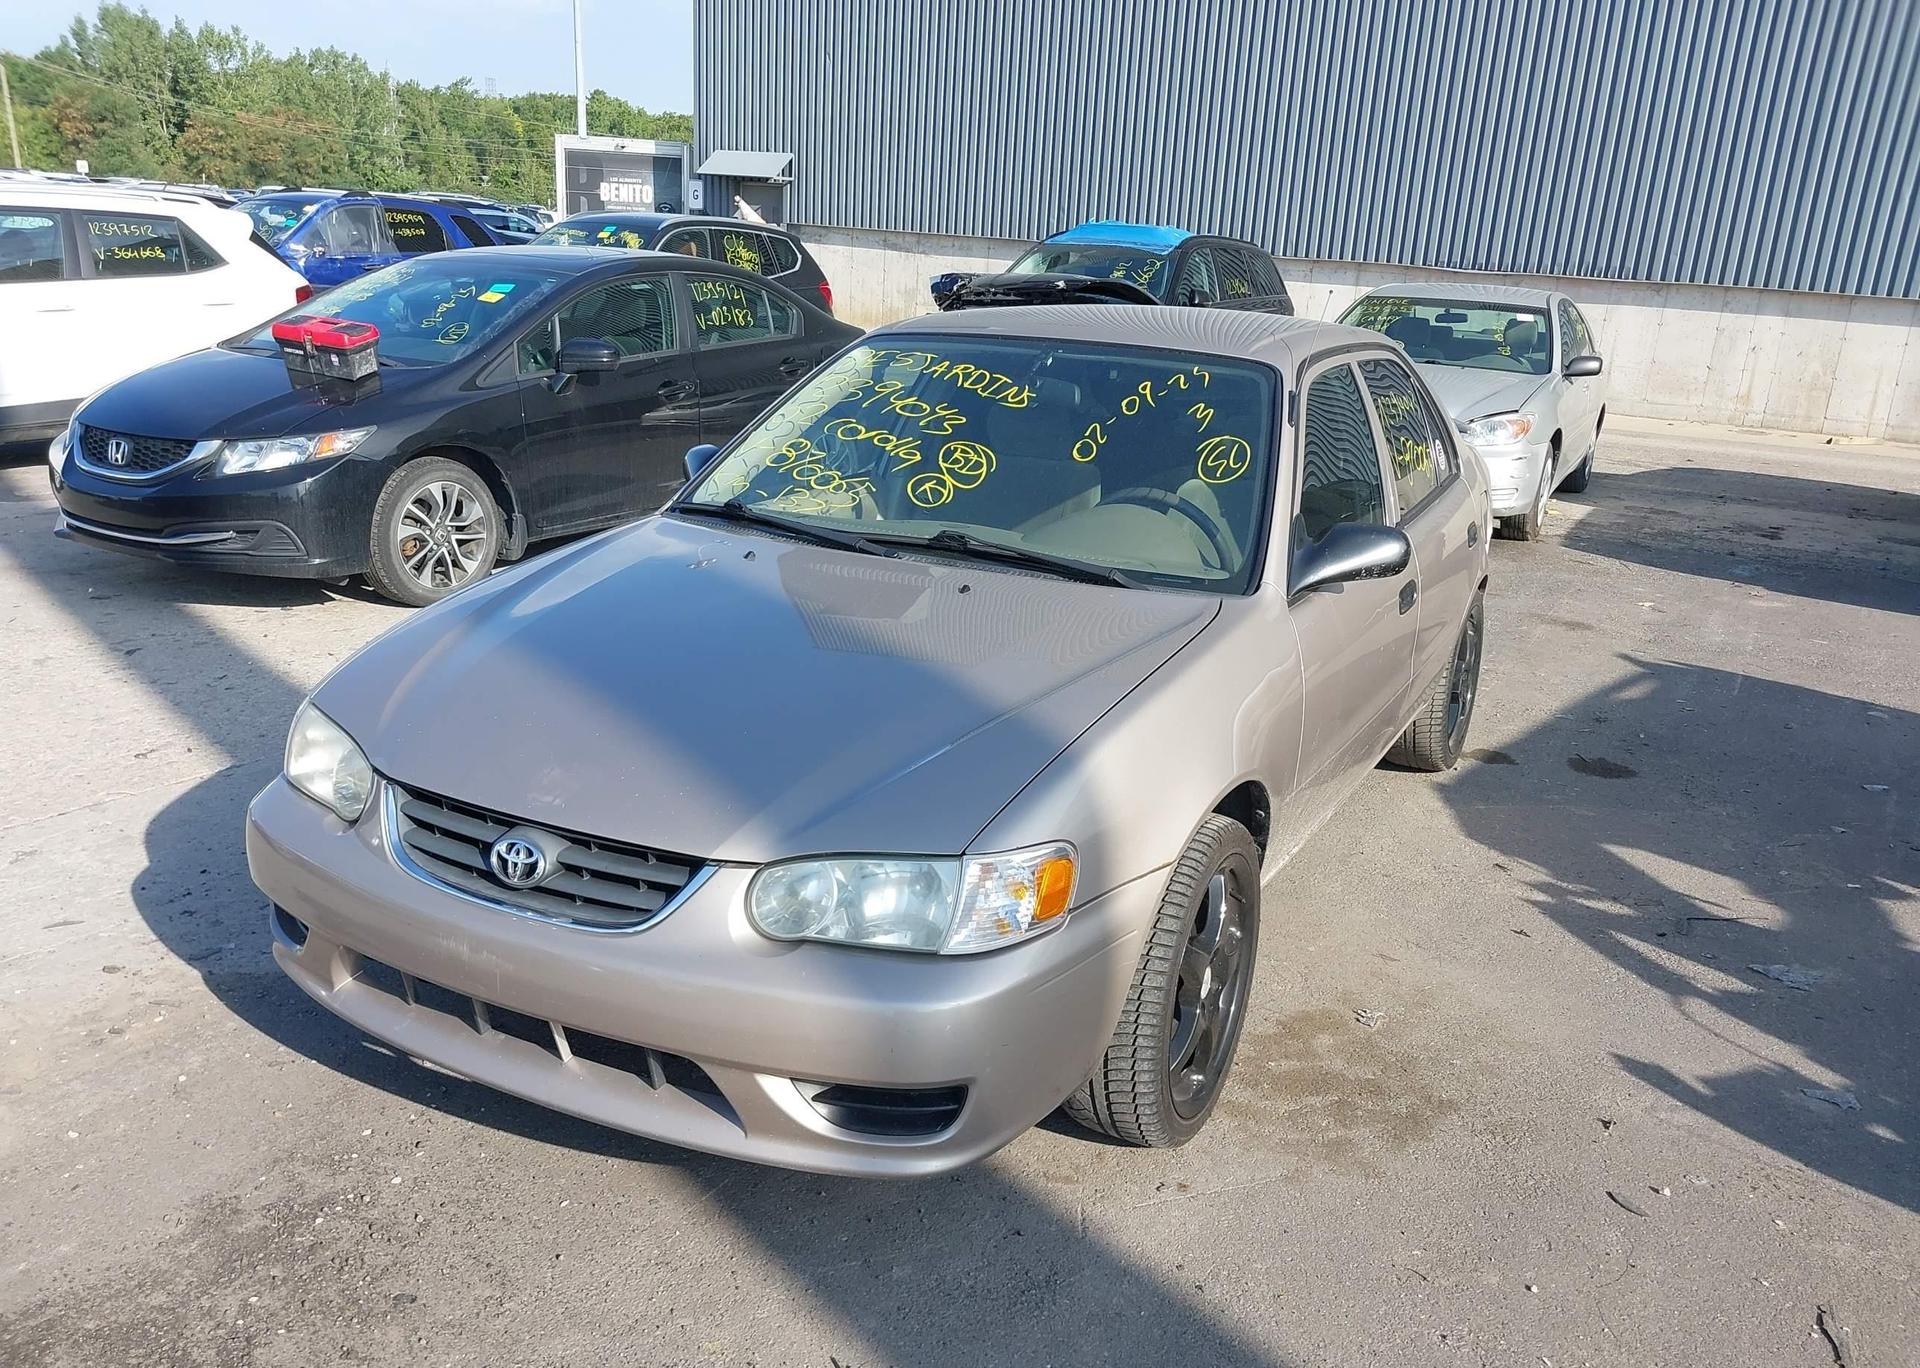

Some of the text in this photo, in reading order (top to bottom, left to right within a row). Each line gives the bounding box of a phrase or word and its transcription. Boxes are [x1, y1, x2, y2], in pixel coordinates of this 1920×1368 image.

[600, 182, 653, 204] BENITO
[692, 189, 700, 201] G
[88, 221, 159, 238] 12397512
